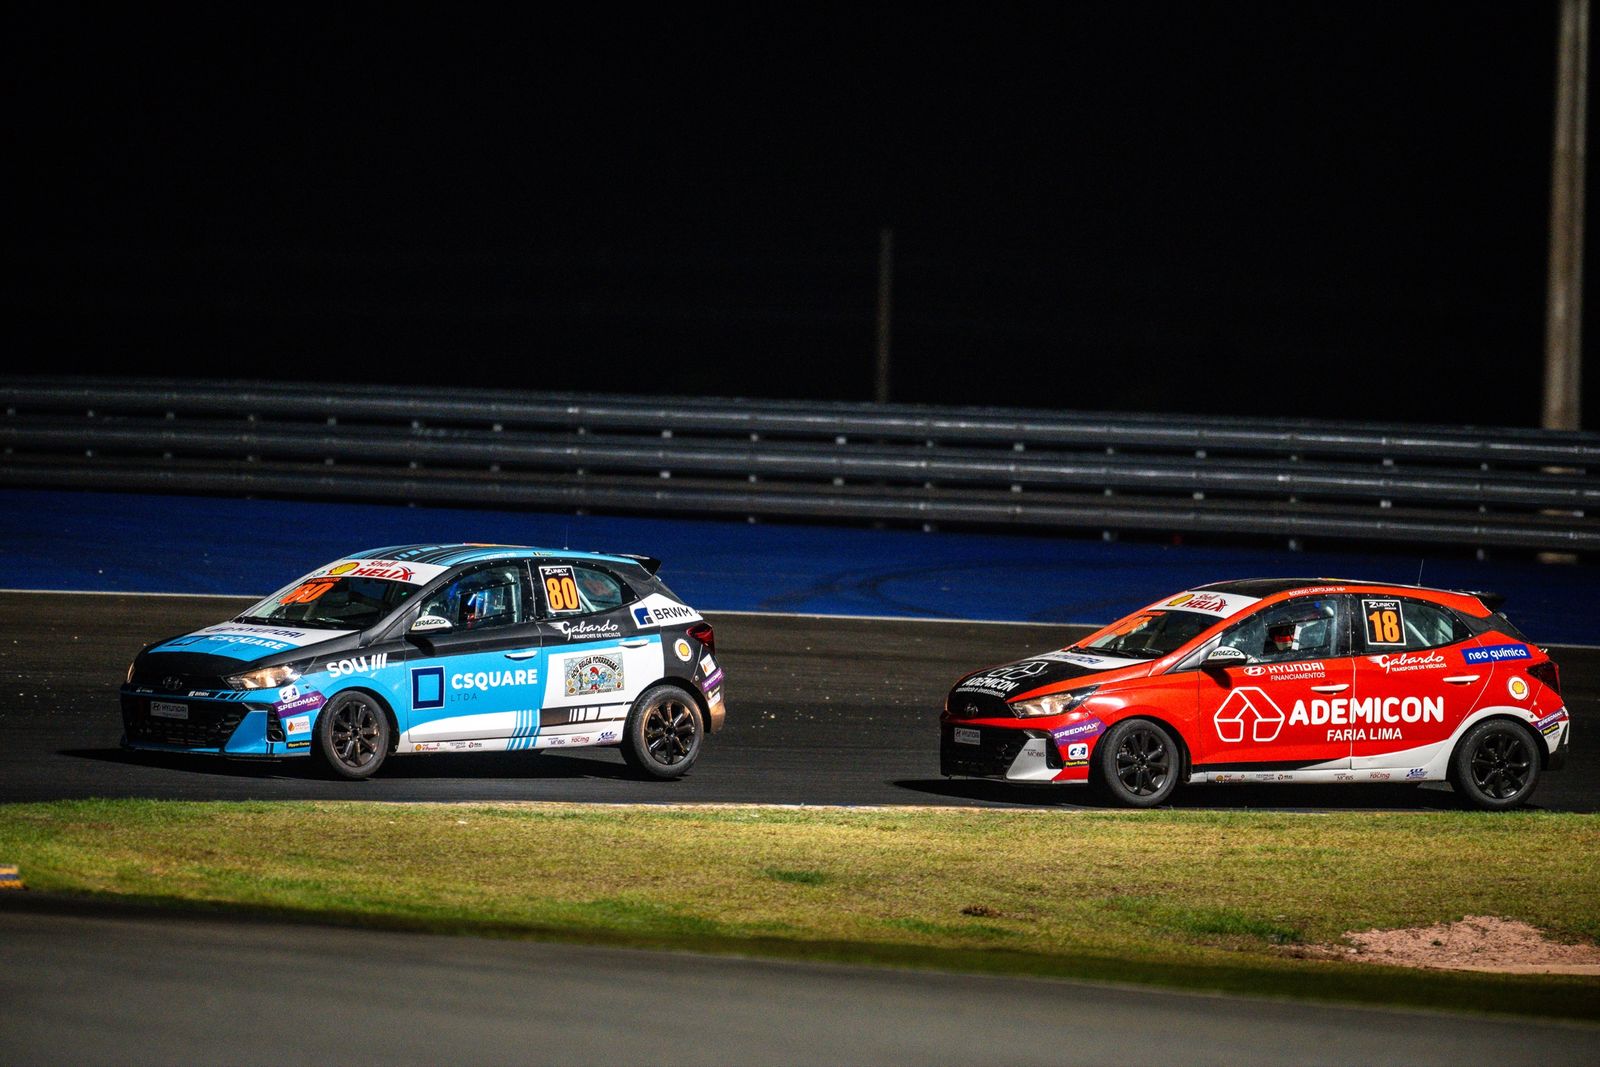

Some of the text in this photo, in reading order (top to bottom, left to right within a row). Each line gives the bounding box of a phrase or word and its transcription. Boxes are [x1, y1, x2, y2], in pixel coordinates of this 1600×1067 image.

[367, 560, 397, 568] Shell
[351, 567, 415, 581] HELIX
[546, 577, 578, 610] 80
[1184, 598, 1226, 612] HELIX
[1369, 601, 1396, 609] ZUNKY
[653, 606, 692, 620] BRWM
[561, 619, 619, 641] Gabardo
[1369, 611, 1400, 642] 18
[1379, 651, 1445, 674] Gabardo
[1468, 650, 1488, 661] neo
[326, 656, 369, 678] SOU
[1267, 662, 1325, 674] HYUNDAI
[451, 669, 538, 691] CSQUARE
[1270, 671, 1326, 681] FINANCIAMENTOS
[278, 696, 318, 711] SPEEDMAX
[451, 692, 477, 702] LTDA
[1288, 696, 1444, 725] ADEMICON
[1054, 722, 1097, 738] SPEEDMAX
[1326, 728, 1403, 742] FARIA LIMA
